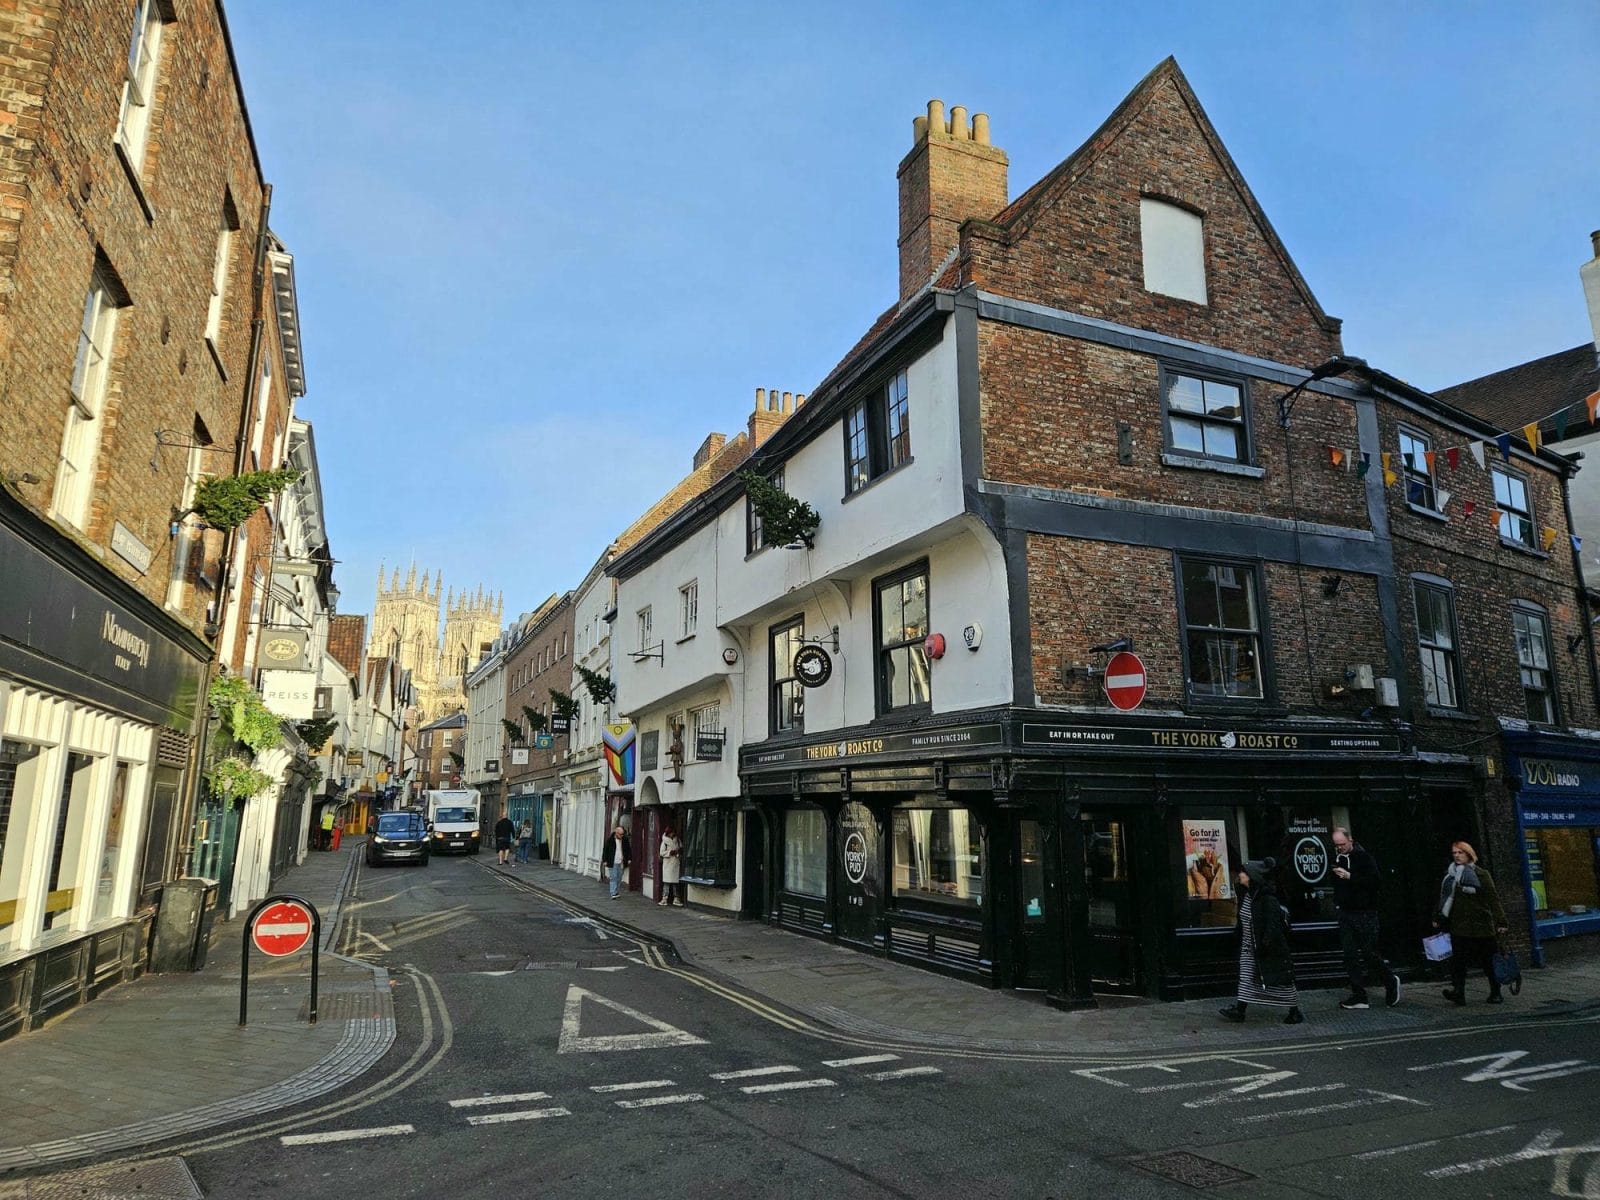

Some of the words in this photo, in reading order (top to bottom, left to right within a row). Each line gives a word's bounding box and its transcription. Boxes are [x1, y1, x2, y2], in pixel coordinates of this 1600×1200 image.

[103, 611, 150, 669] NOMINATION
[115, 654, 131, 671] ITALY
[268, 691, 309, 700] REISS
[1049, 731, 1062, 739] EAT
[1063, 731, 1071, 739] IN
[1082, 732, 1100, 740] TAKE
[1151, 732, 1179, 745] THE
[1182, 732, 1218, 746] YORK
[1239, 734, 1281, 748] ROAST
[806, 748, 819, 759] THE
[819, 745, 838, 758] YORK
[847, 741, 872, 755] ROAST
[1557, 773, 1580, 787] RADIO
[1190, 829, 1199, 837] Go
[1201, 829, 1211, 837] for
[1211, 829, 1220, 838] it!
[846, 851, 865, 863] YORKY
[1297, 854, 1324, 864] YORKY
[849, 862, 862, 873] PUD
[1303, 864, 1320, 874] PUD
